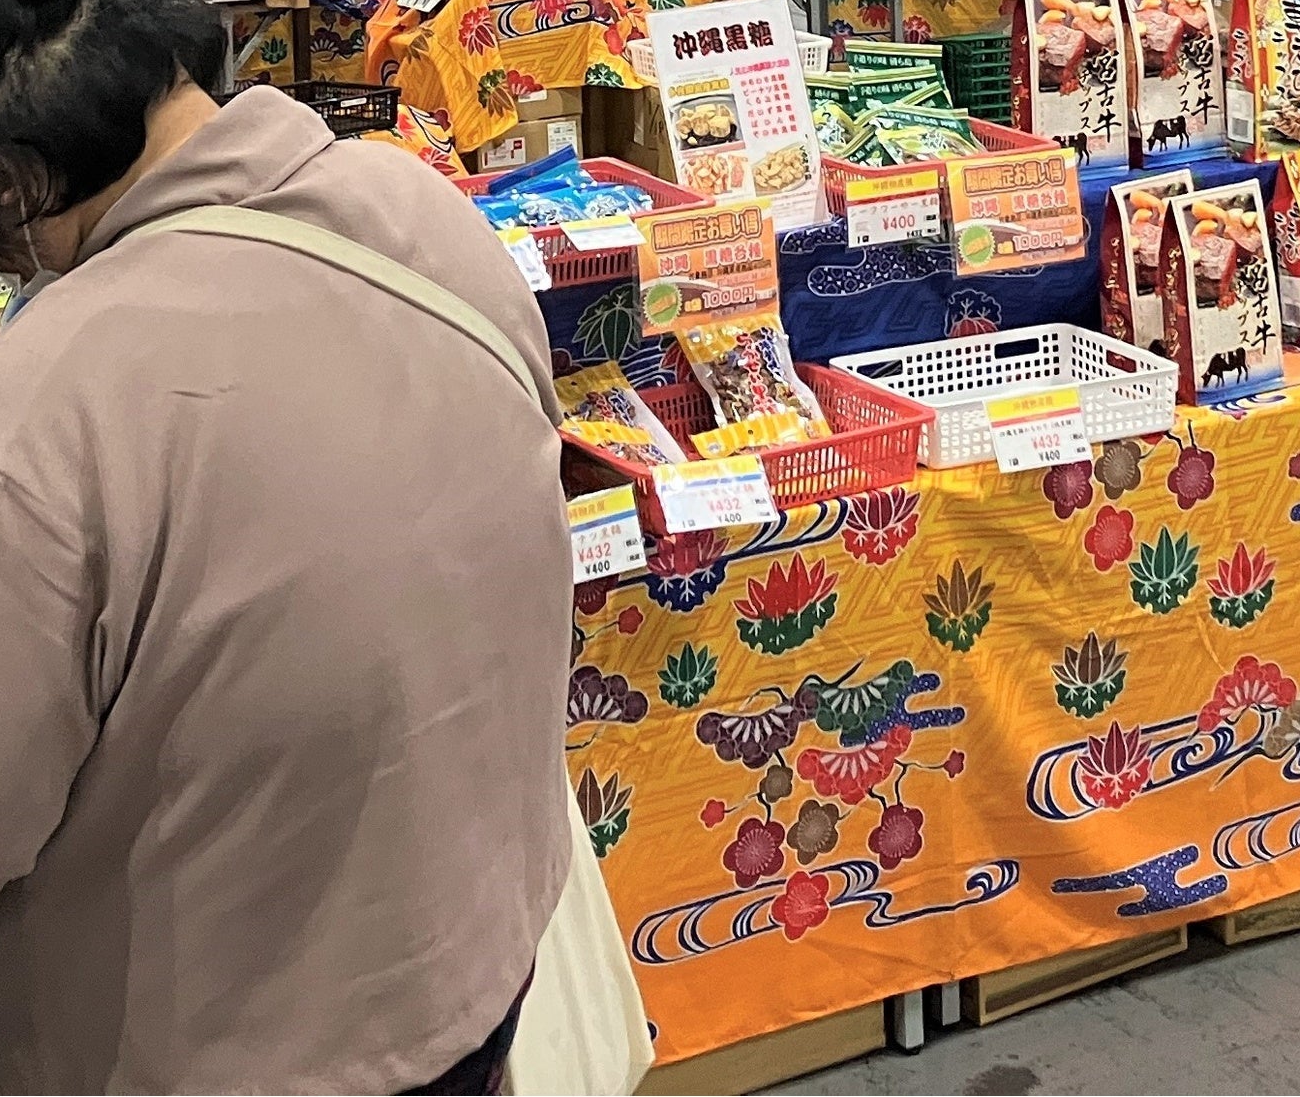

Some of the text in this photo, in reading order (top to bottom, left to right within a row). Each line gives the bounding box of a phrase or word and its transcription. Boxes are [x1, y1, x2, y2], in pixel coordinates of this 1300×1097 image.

[672, 20, 774, 60] 沖縄黒糖
[1190, 34, 1219, 125] 宮古牛
[1092, 48, 1121, 144] 宮古牛
[883, 214, 915, 230] ¥400
[1013, 230, 1063, 252] 1000円
[703, 285, 755, 308] 1000円
[1251, 255, 1276, 355] 宮古牛
[1032, 434, 1060, 450] ¥432
[1040, 450, 1061, 462] ¥400
[708, 498, 742, 512] ¥432
[578, 542, 612, 563] ¥432
[585, 560, 611, 574] ¥400
